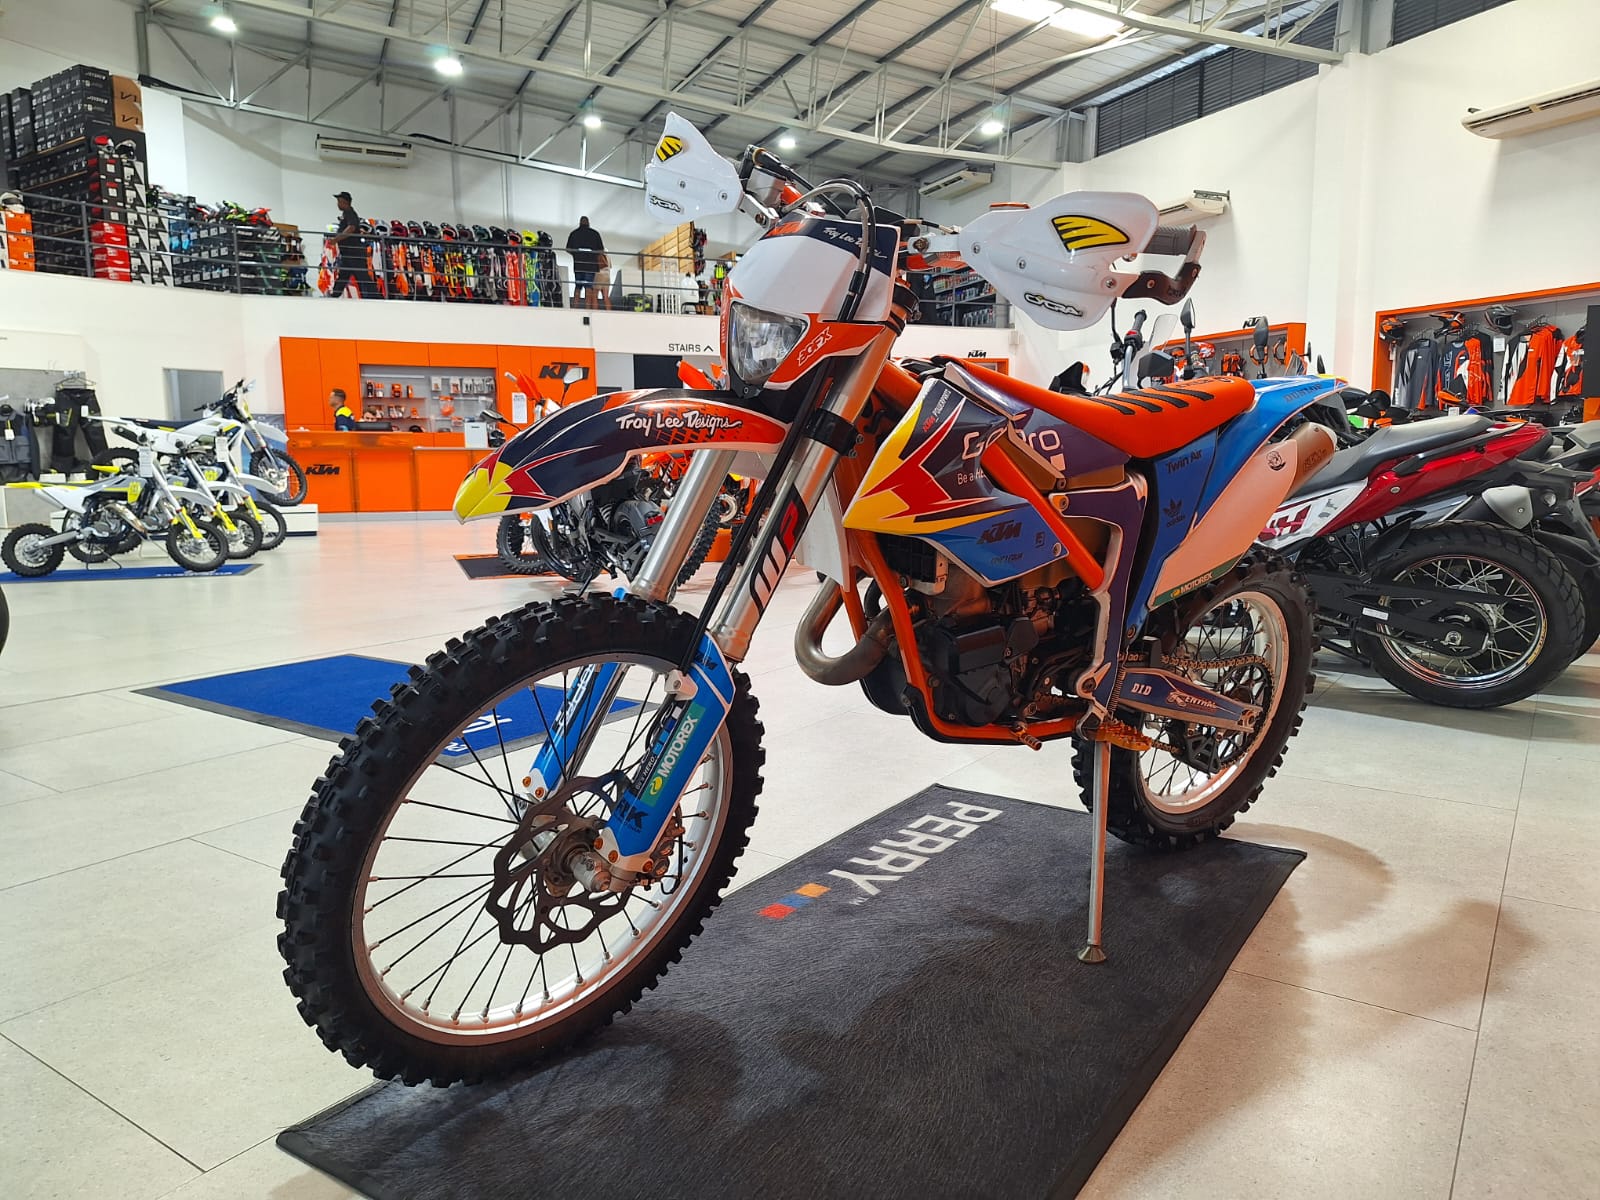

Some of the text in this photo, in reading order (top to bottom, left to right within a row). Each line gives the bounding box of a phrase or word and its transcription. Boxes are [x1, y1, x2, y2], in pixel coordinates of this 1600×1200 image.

[668, 343, 701, 353] STAIRS
[968, 349, 987, 358] KTM
[616, 410, 742, 437] Troy Lee Designs
[305, 464, 341, 475] KTM
[1165, 455, 1189, 475] Twin
[957, 473, 968, 485] Be
[969, 472, 974, 481] a
[976, 519, 1023, 545] KTM
[1180, 571, 1213, 595] MOTOREX
[1131, 683, 1152, 696] DID
[657, 715, 698, 778] MOTOREX
[828, 801, 1003, 896] PERRY
